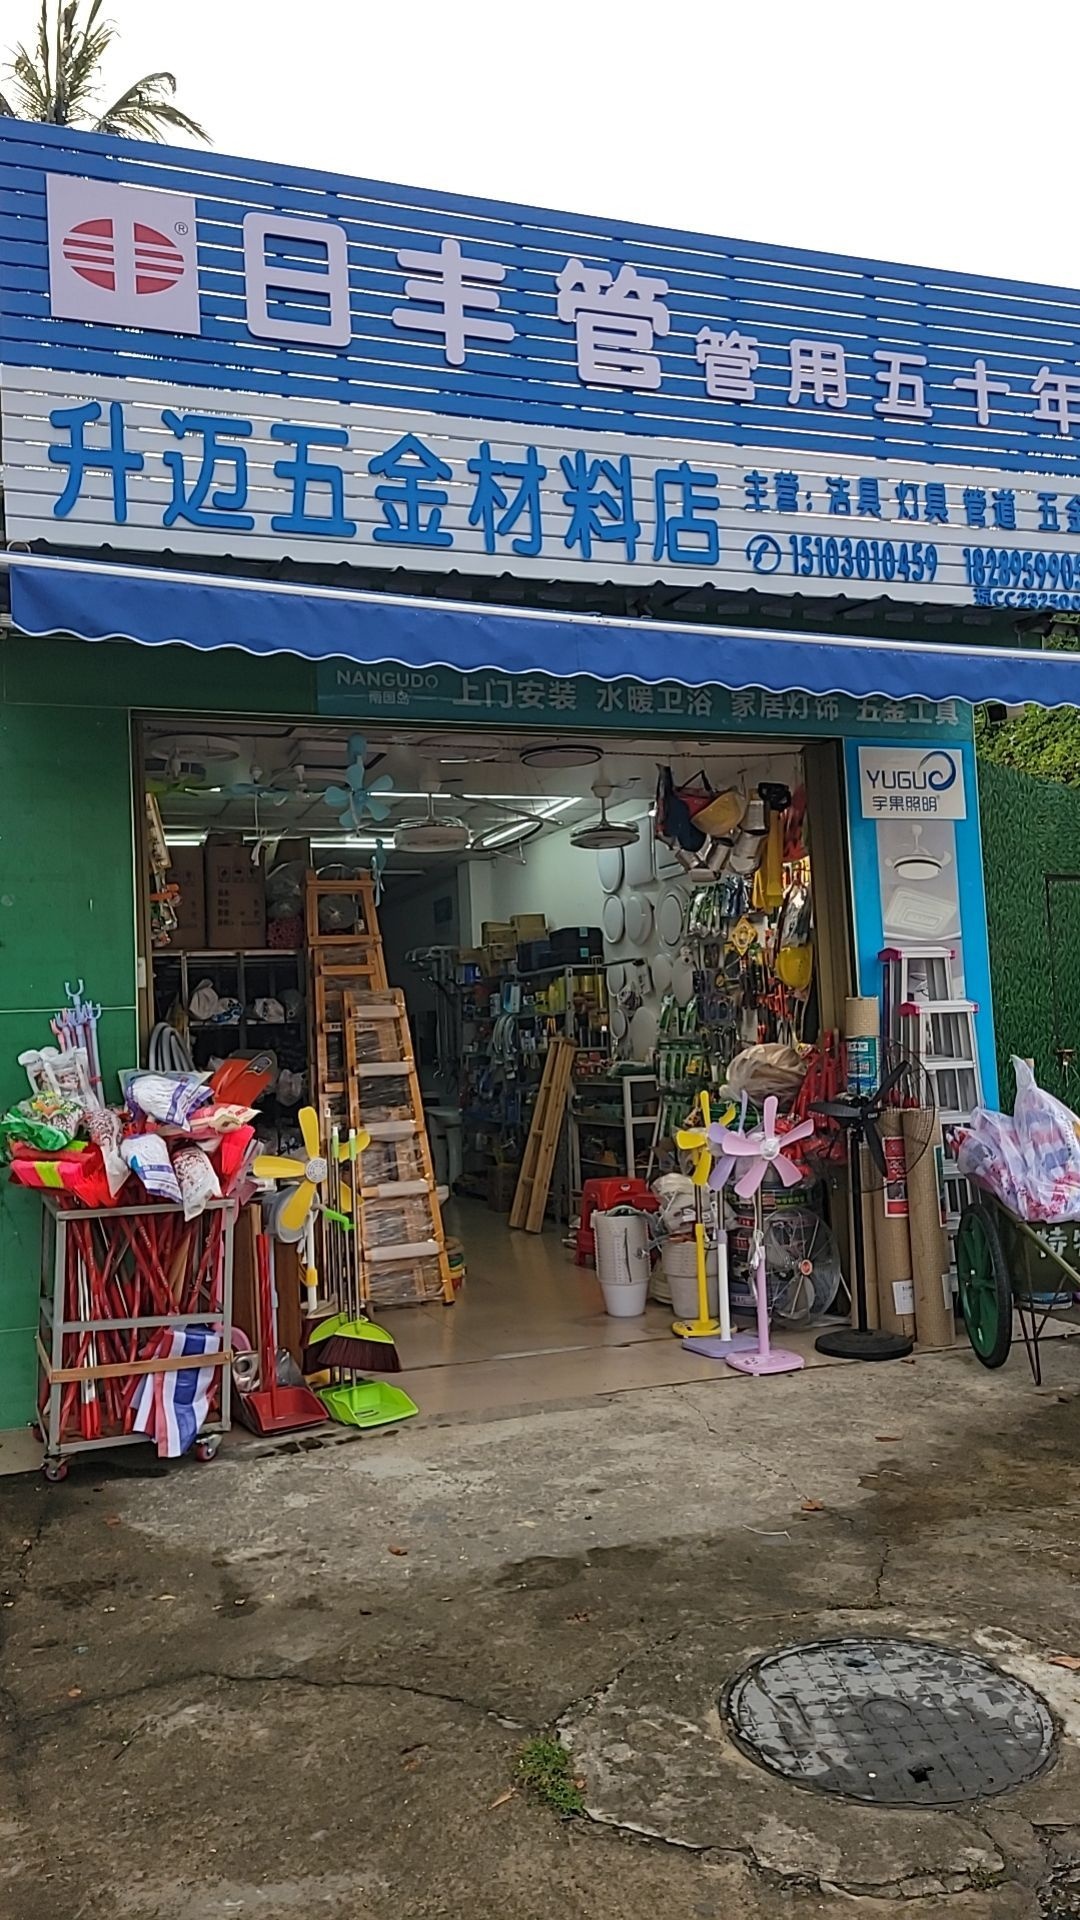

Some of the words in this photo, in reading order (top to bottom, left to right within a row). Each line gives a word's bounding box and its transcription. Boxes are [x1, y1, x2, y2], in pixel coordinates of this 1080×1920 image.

[243, 212, 669, 389] 日丰管
[696, 326, 1080, 433] 管用五十年
[48, 402, 720, 565] 升迈五金材料店
[895, 480, 949, 523] 灯具
[963, 488, 1016, 530] 管道
[789, 535, 938, 581] 15103010459
[336, 670, 439, 688] NANGUDO
[453, 677, 577, 710] 上门安装
[596, 684, 713, 717] 水暖卫浴
[731, 690, 839, 721] 家居灯饰
[872, 795, 938, 812] 宇果照明
